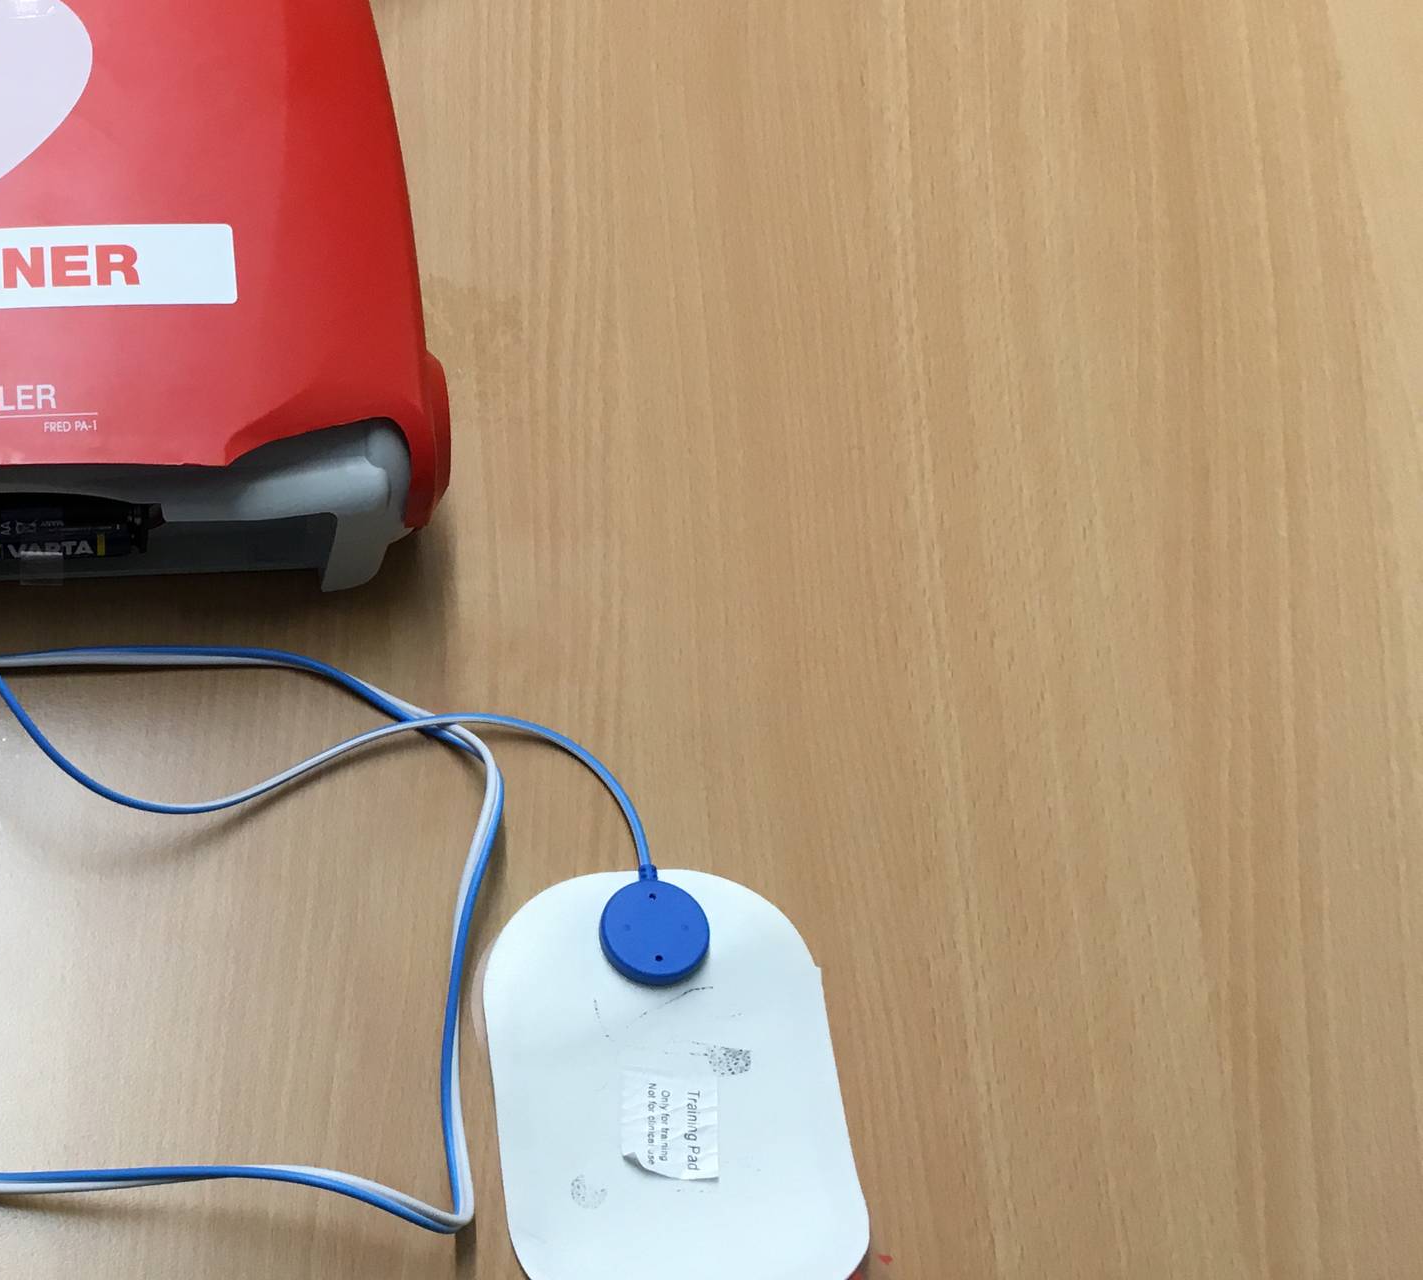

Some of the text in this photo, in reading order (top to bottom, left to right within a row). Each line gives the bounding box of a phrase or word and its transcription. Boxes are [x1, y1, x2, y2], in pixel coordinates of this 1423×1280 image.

[43, 420, 97, 433] FRED PA-1
[6, 539, 95, 559] VARTA
[647, 1082, 657, 1165] Not for clinical use
[658, 1089, 671, 1161] Only for training
[683, 1090, 701, 1171] Training Pad
